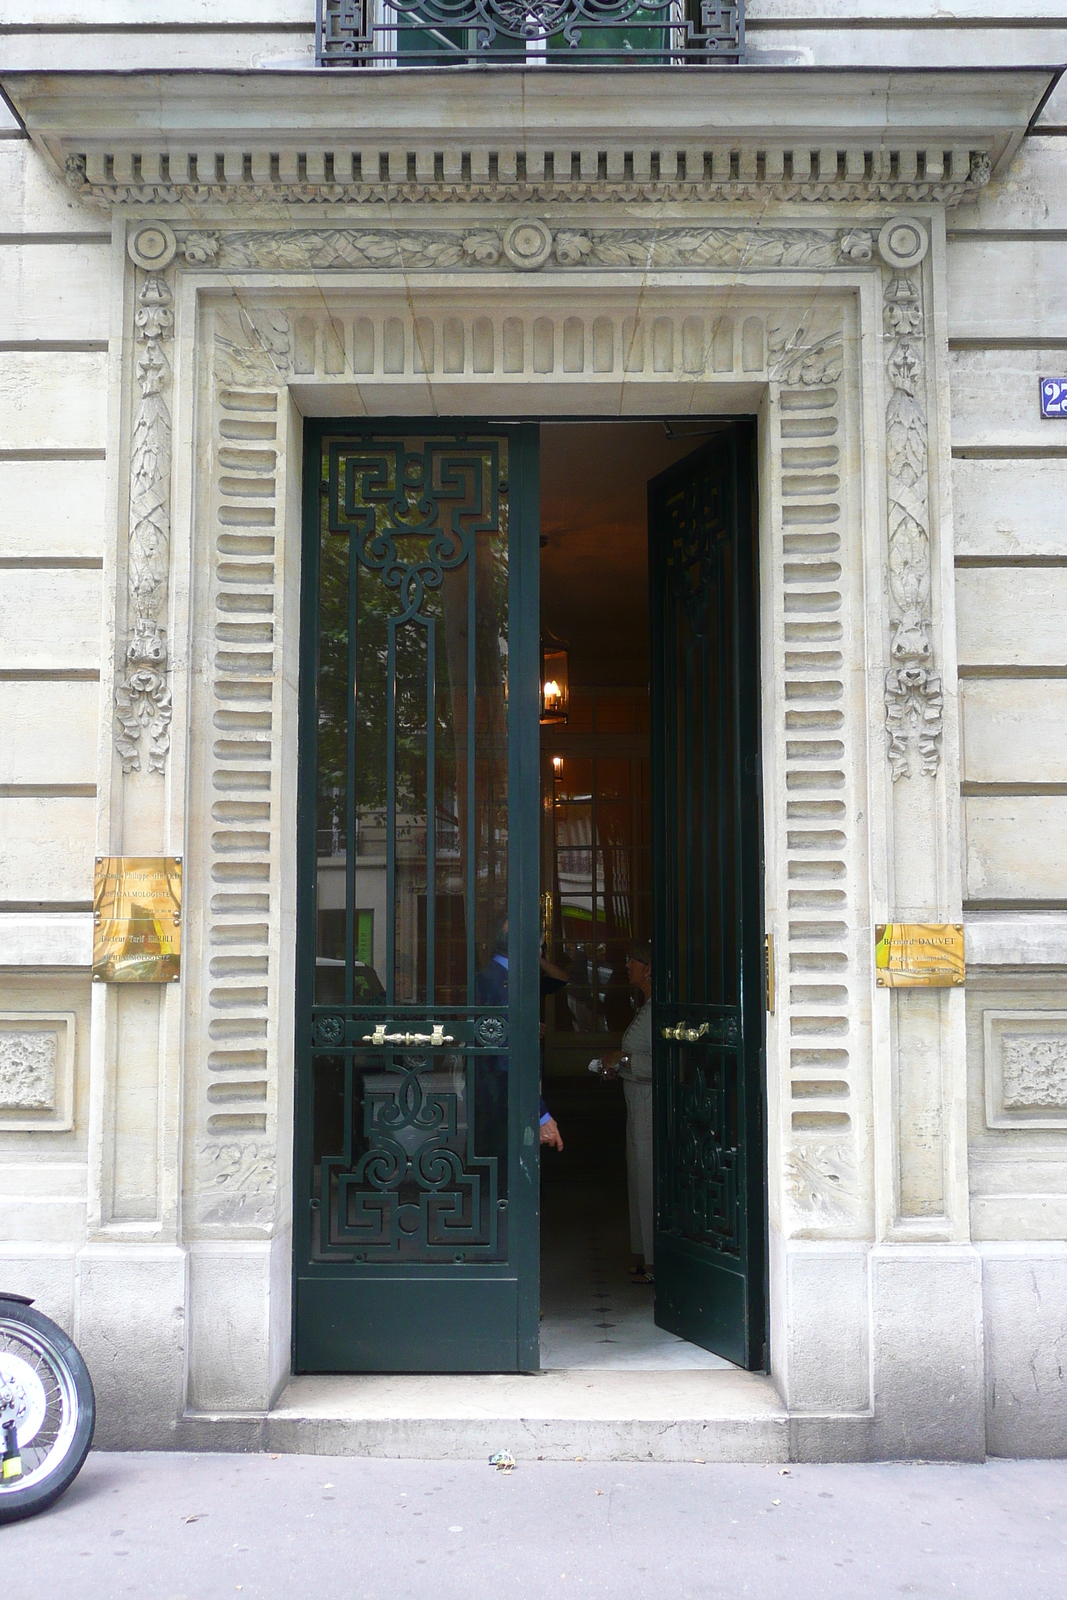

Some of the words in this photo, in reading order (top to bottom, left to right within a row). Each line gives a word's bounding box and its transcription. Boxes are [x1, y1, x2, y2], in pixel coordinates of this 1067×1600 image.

[125, 871, 149, 881] Philippe
[101, 935, 126, 943] Docteur
[129, 935, 145, 943] Tarif
[884, 938, 914, 946] Bernard
[918, 938, 956, 946] DAUVET
